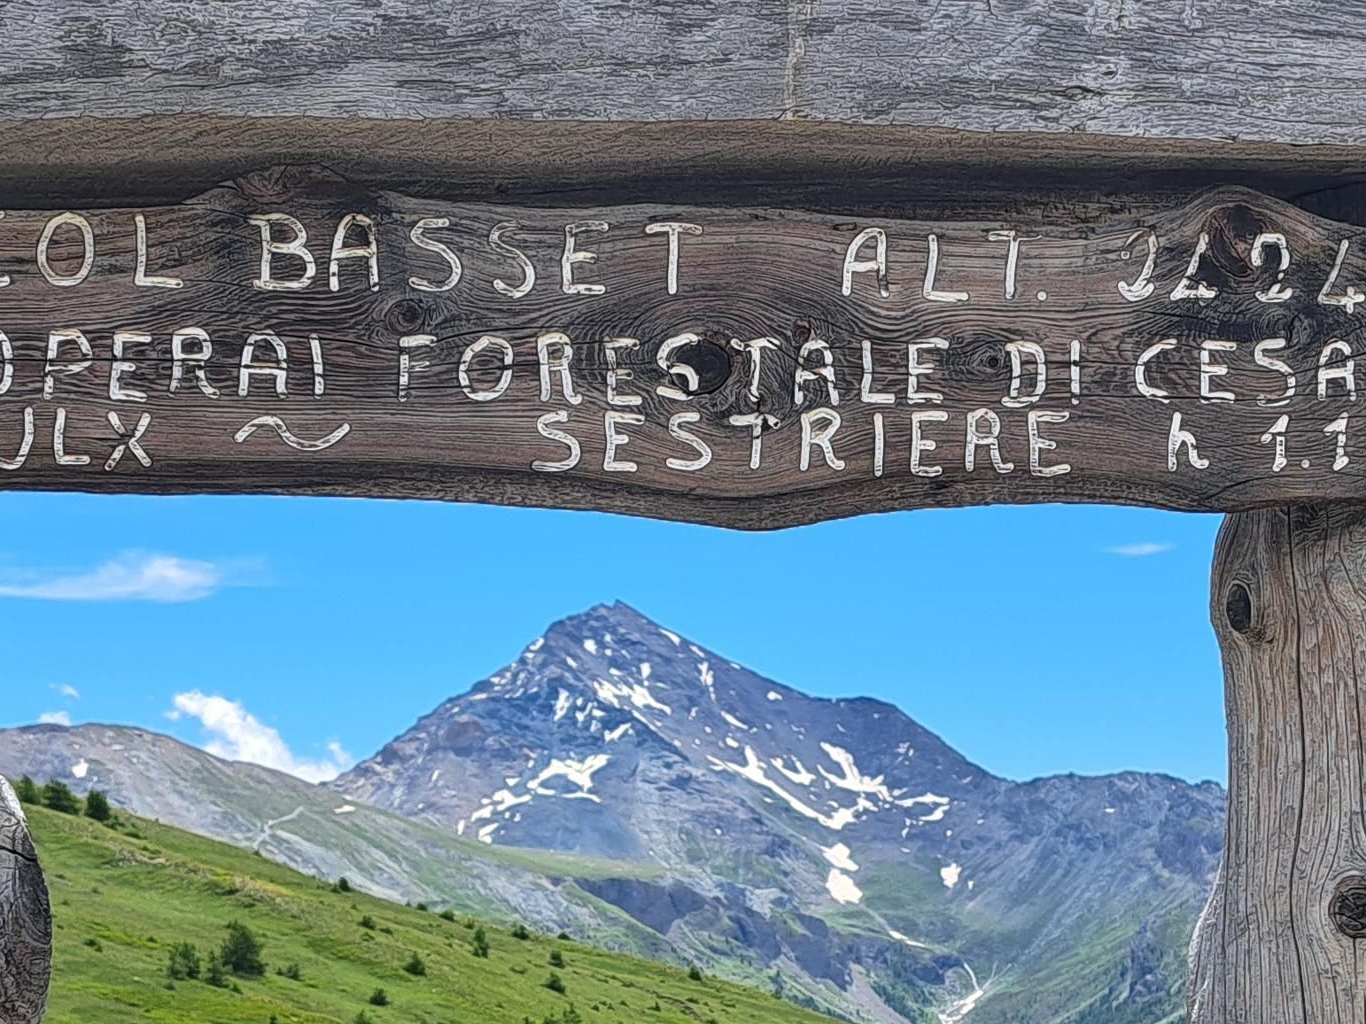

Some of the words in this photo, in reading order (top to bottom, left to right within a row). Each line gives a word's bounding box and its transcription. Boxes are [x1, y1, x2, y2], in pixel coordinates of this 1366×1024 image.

[246, 211, 703, 300] BASSET
[398, 333, 950, 404] FORESTALE
[1000, 338, 1081, 407] DI
[531, 408, 1072, 478] SESTRIERE
